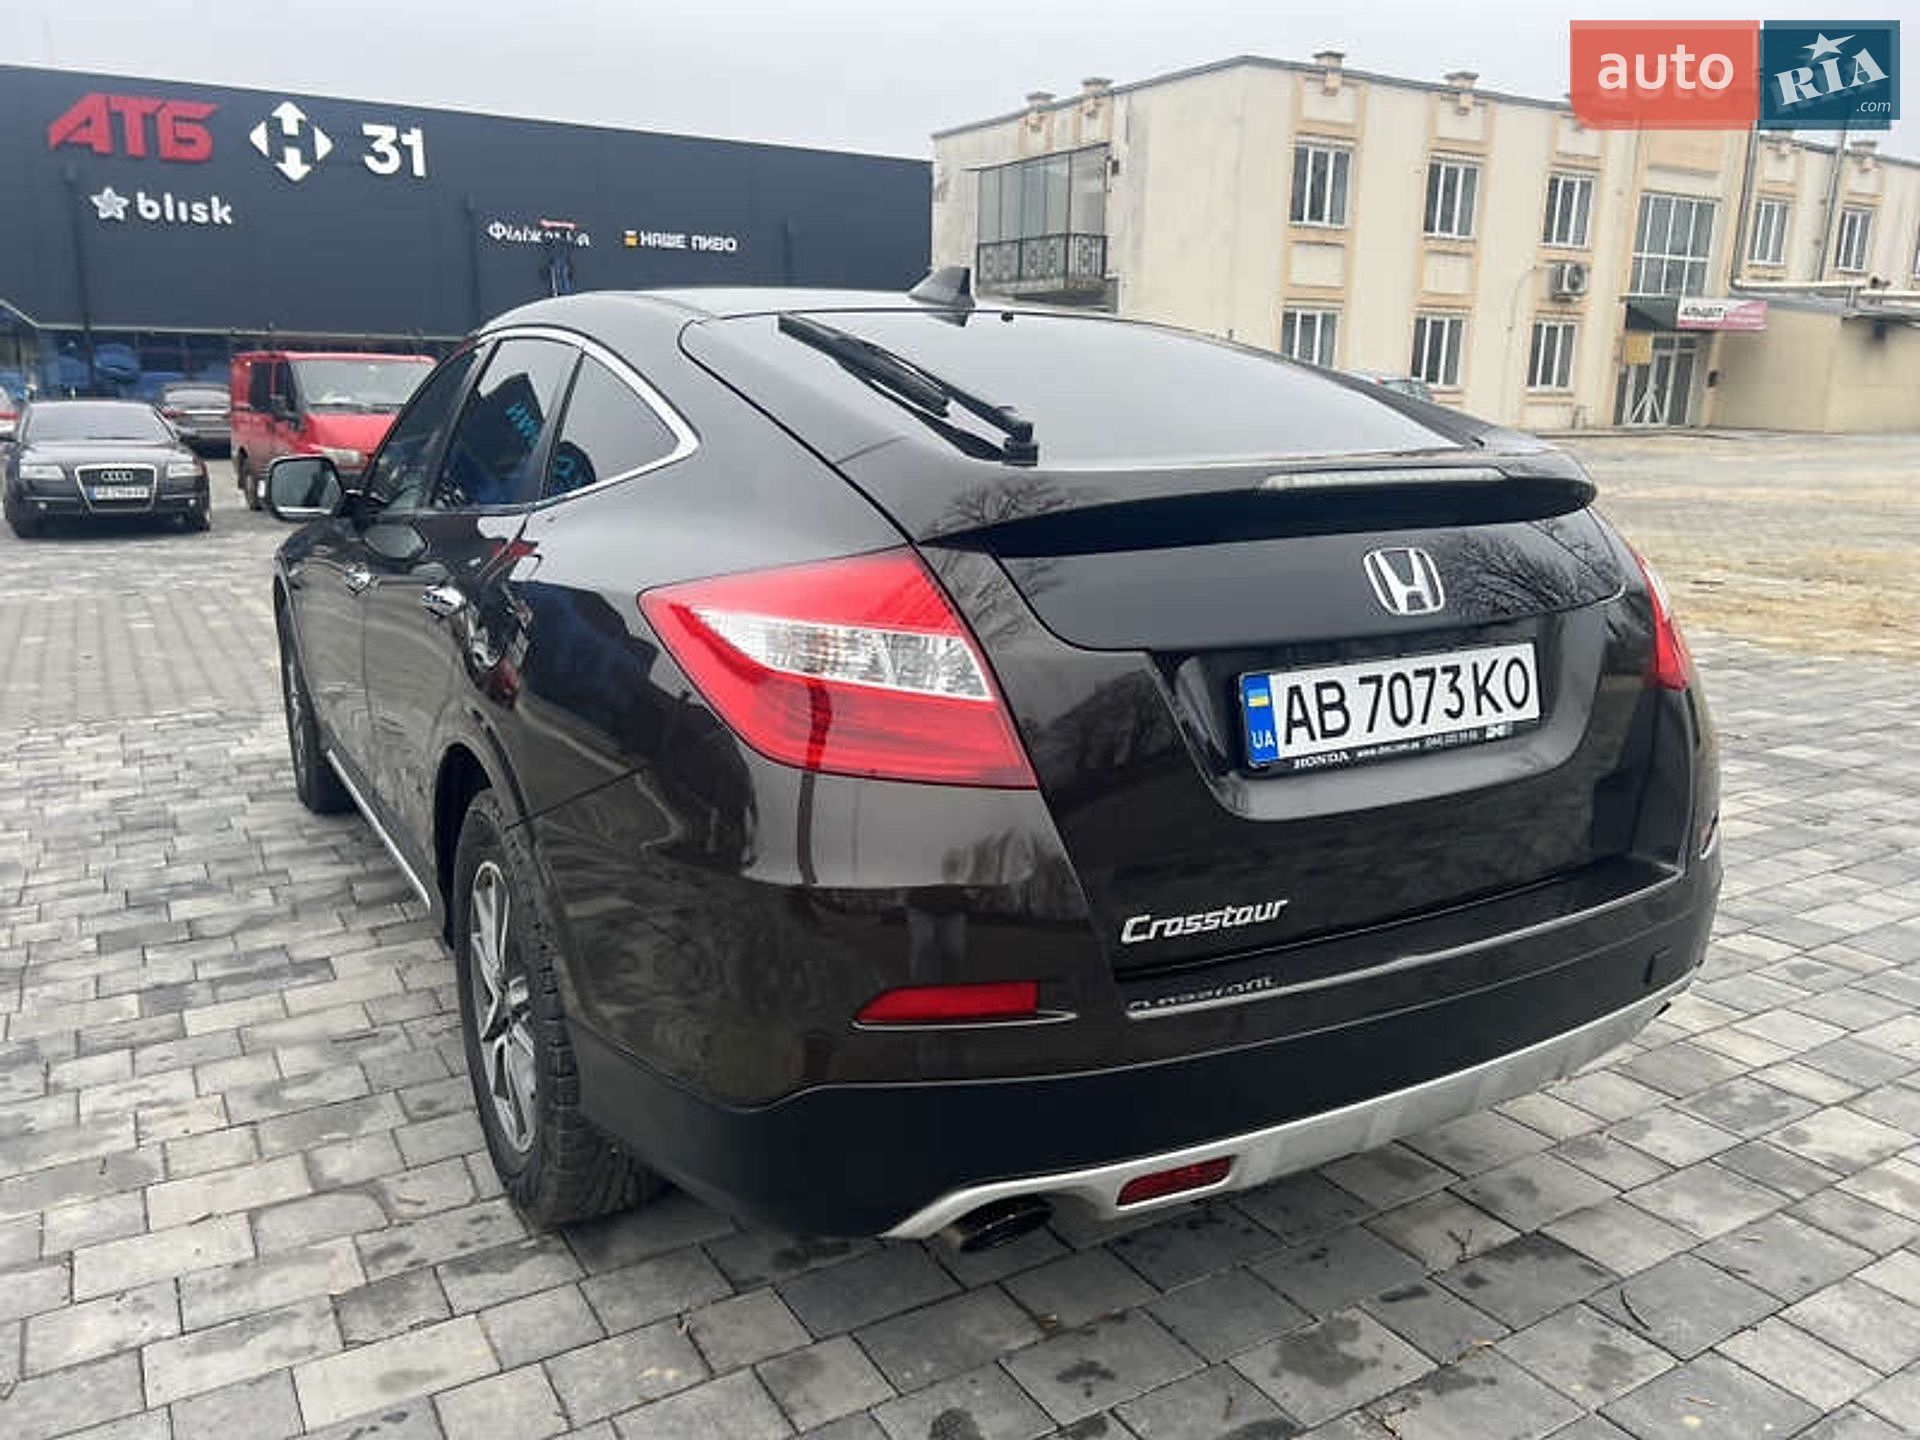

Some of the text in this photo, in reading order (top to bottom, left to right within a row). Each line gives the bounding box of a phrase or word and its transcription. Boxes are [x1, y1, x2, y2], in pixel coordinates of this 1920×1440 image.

[47, 91, 220, 164] АТБ
[361, 122, 428, 178] 31
[137, 192, 233, 225] blisk
[1251, 729, 1276, 750] UA
[1293, 751, 1351, 770] HONDA
[1121, 899, 1289, 945] Crosstour
